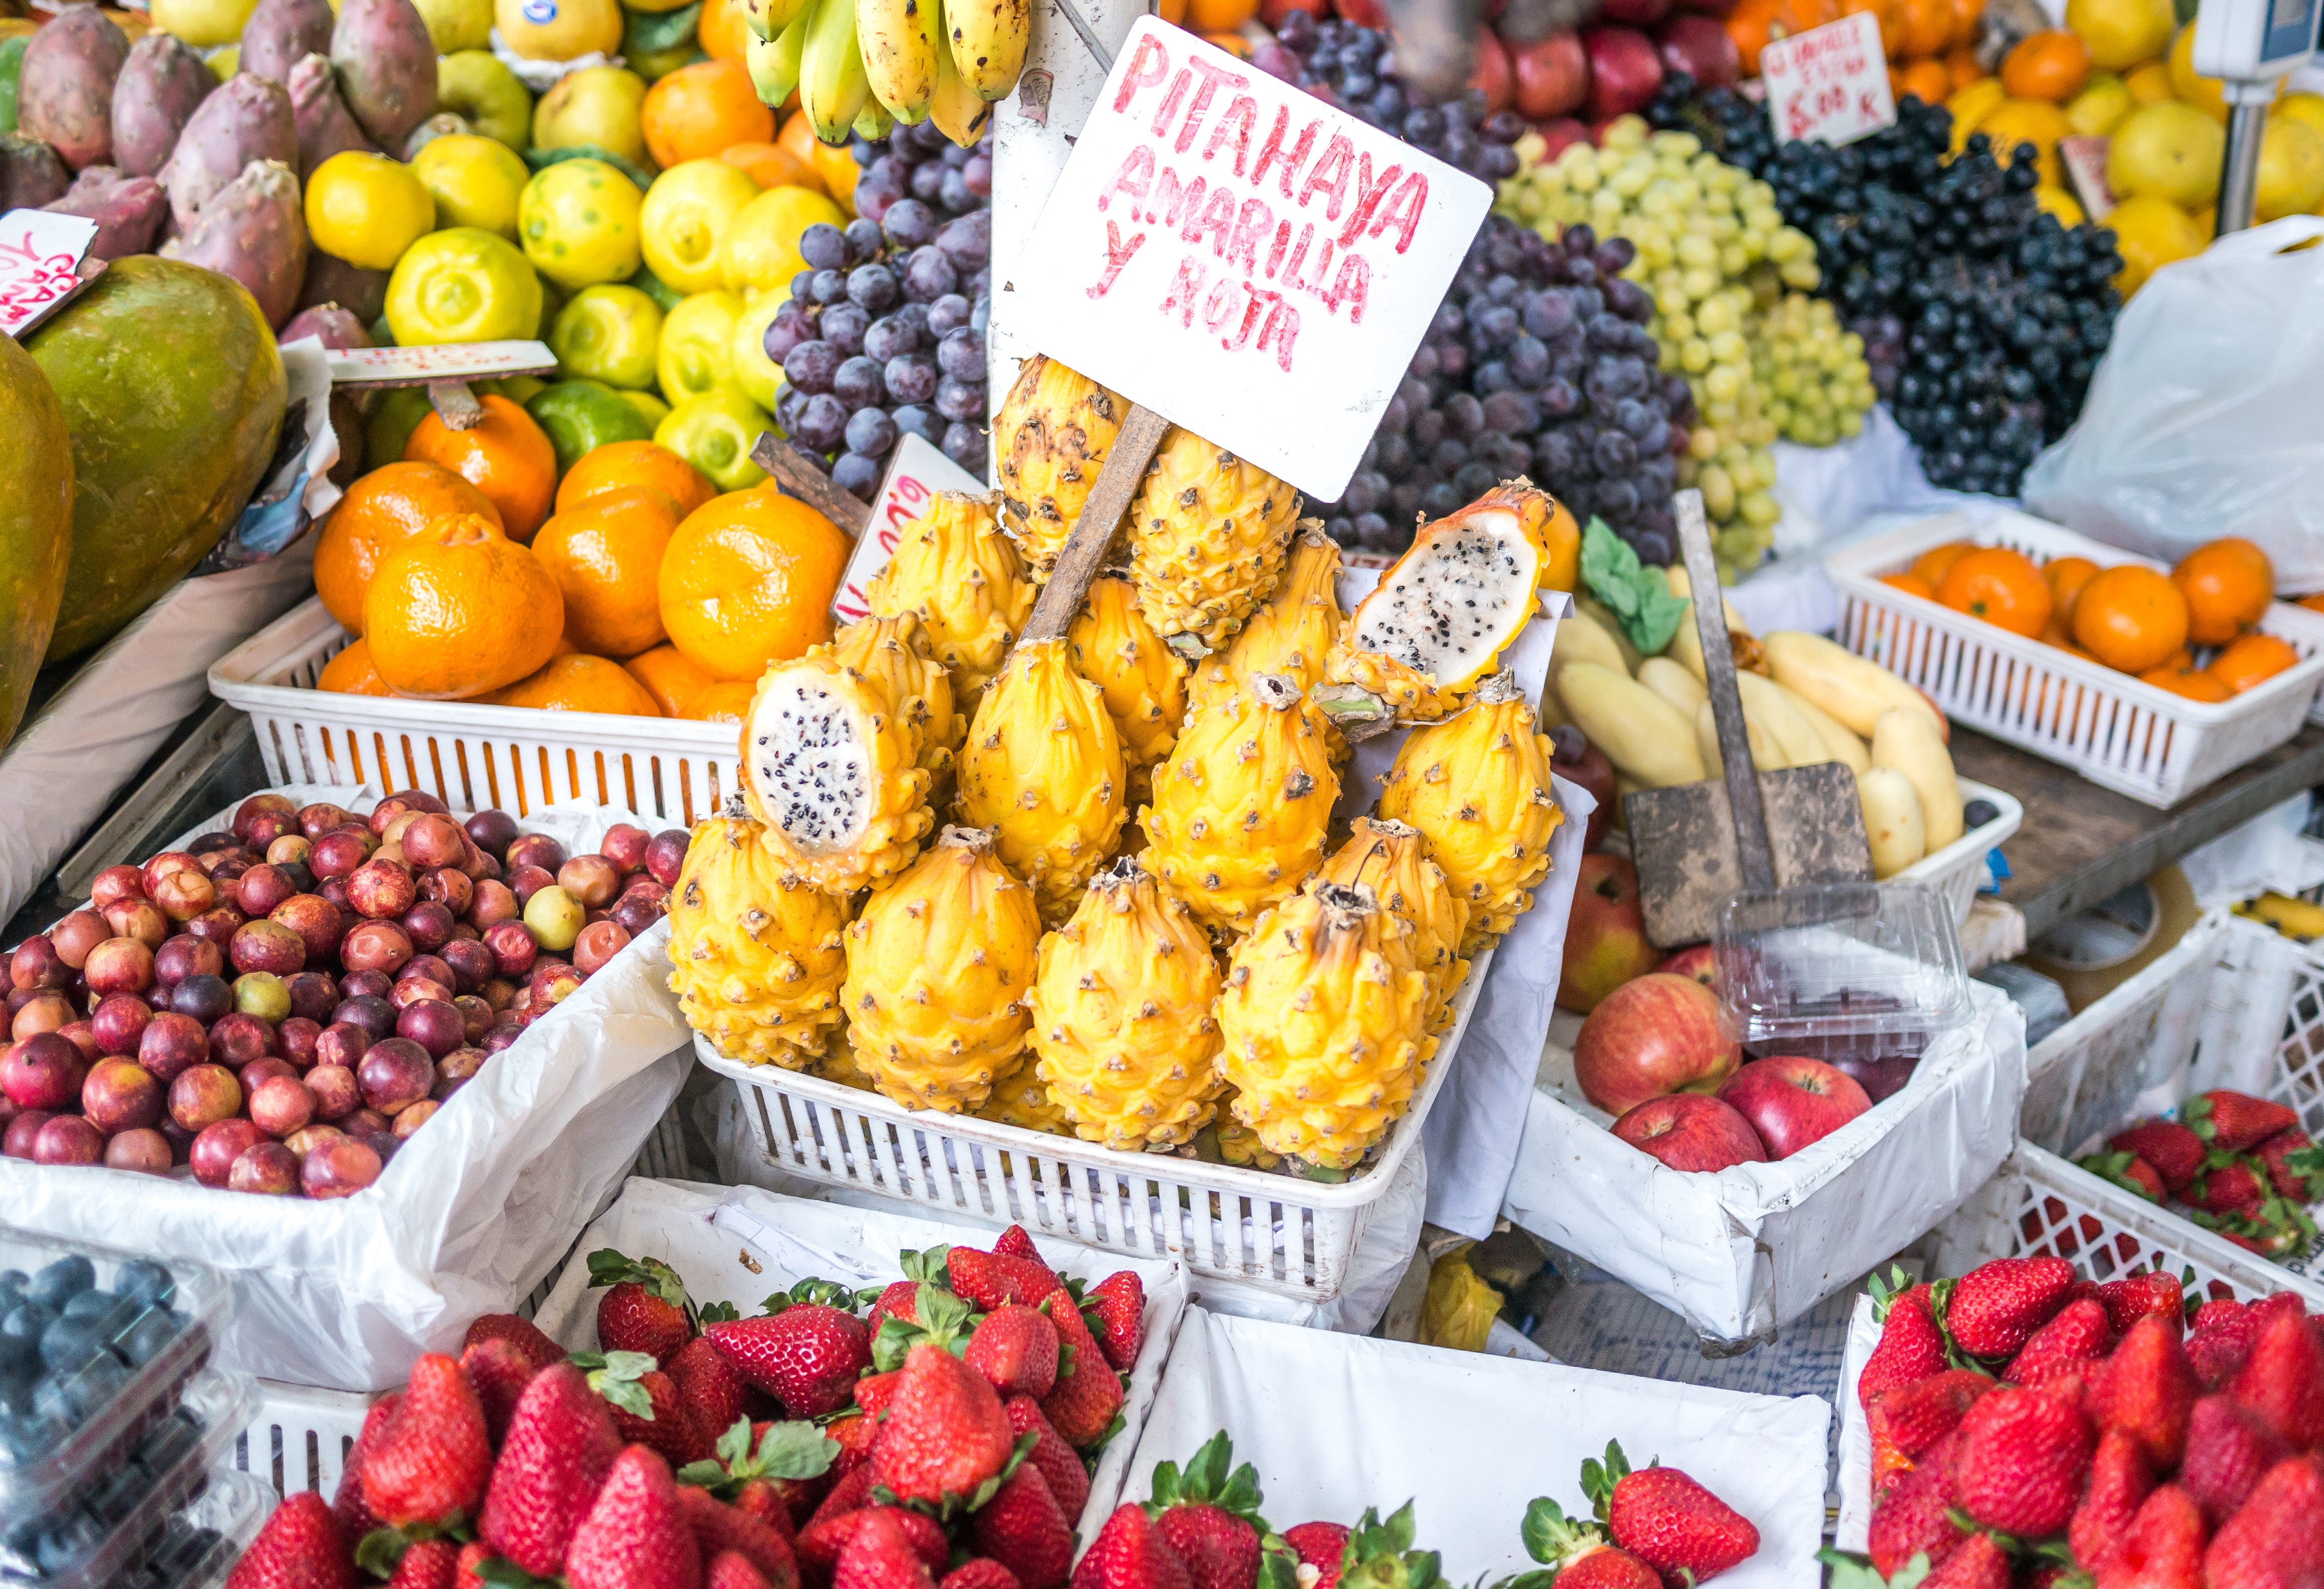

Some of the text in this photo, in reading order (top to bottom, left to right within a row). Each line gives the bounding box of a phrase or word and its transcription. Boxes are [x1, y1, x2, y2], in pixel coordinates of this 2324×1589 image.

[1097, 144, 1370, 325] AMARILLA
[1113, 33, 1428, 255] PITAHAYA
[1086, 219, 1301, 372] Y ROJA
